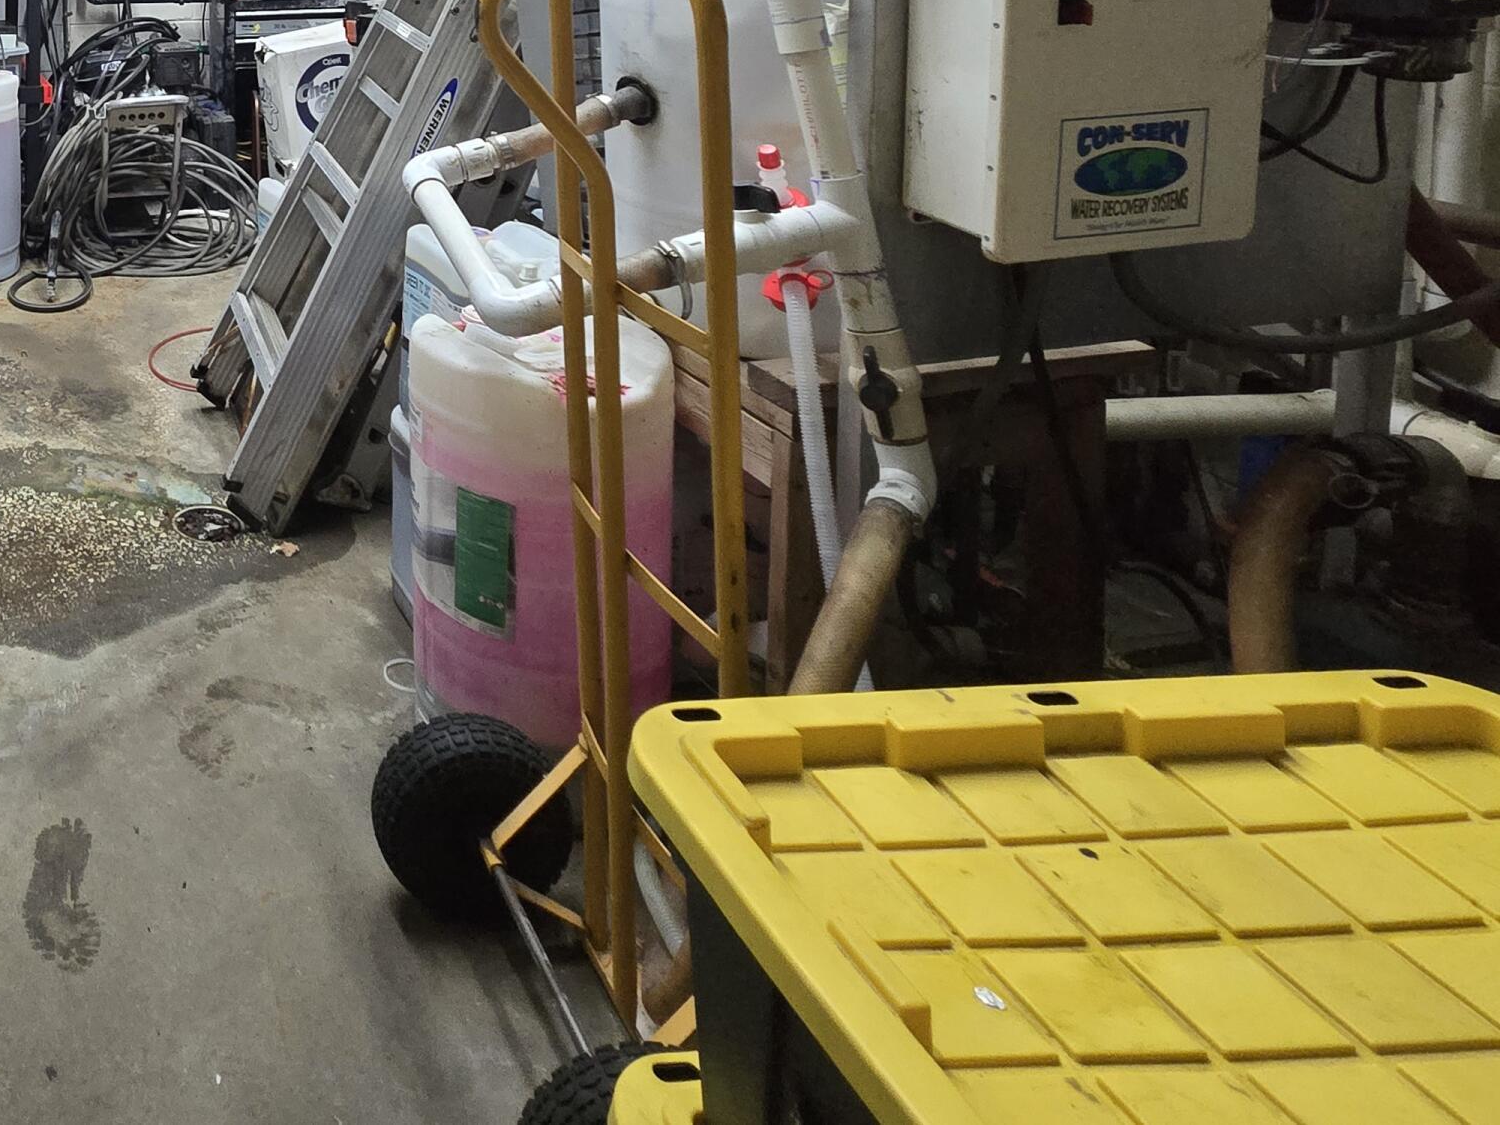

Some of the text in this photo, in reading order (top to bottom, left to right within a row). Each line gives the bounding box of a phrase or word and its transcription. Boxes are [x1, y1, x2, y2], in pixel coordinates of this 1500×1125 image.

[1077, 120, 1190, 157] CON-SERV
[1071, 187, 1189, 219] WATER RECOVERY SYSTEMS
